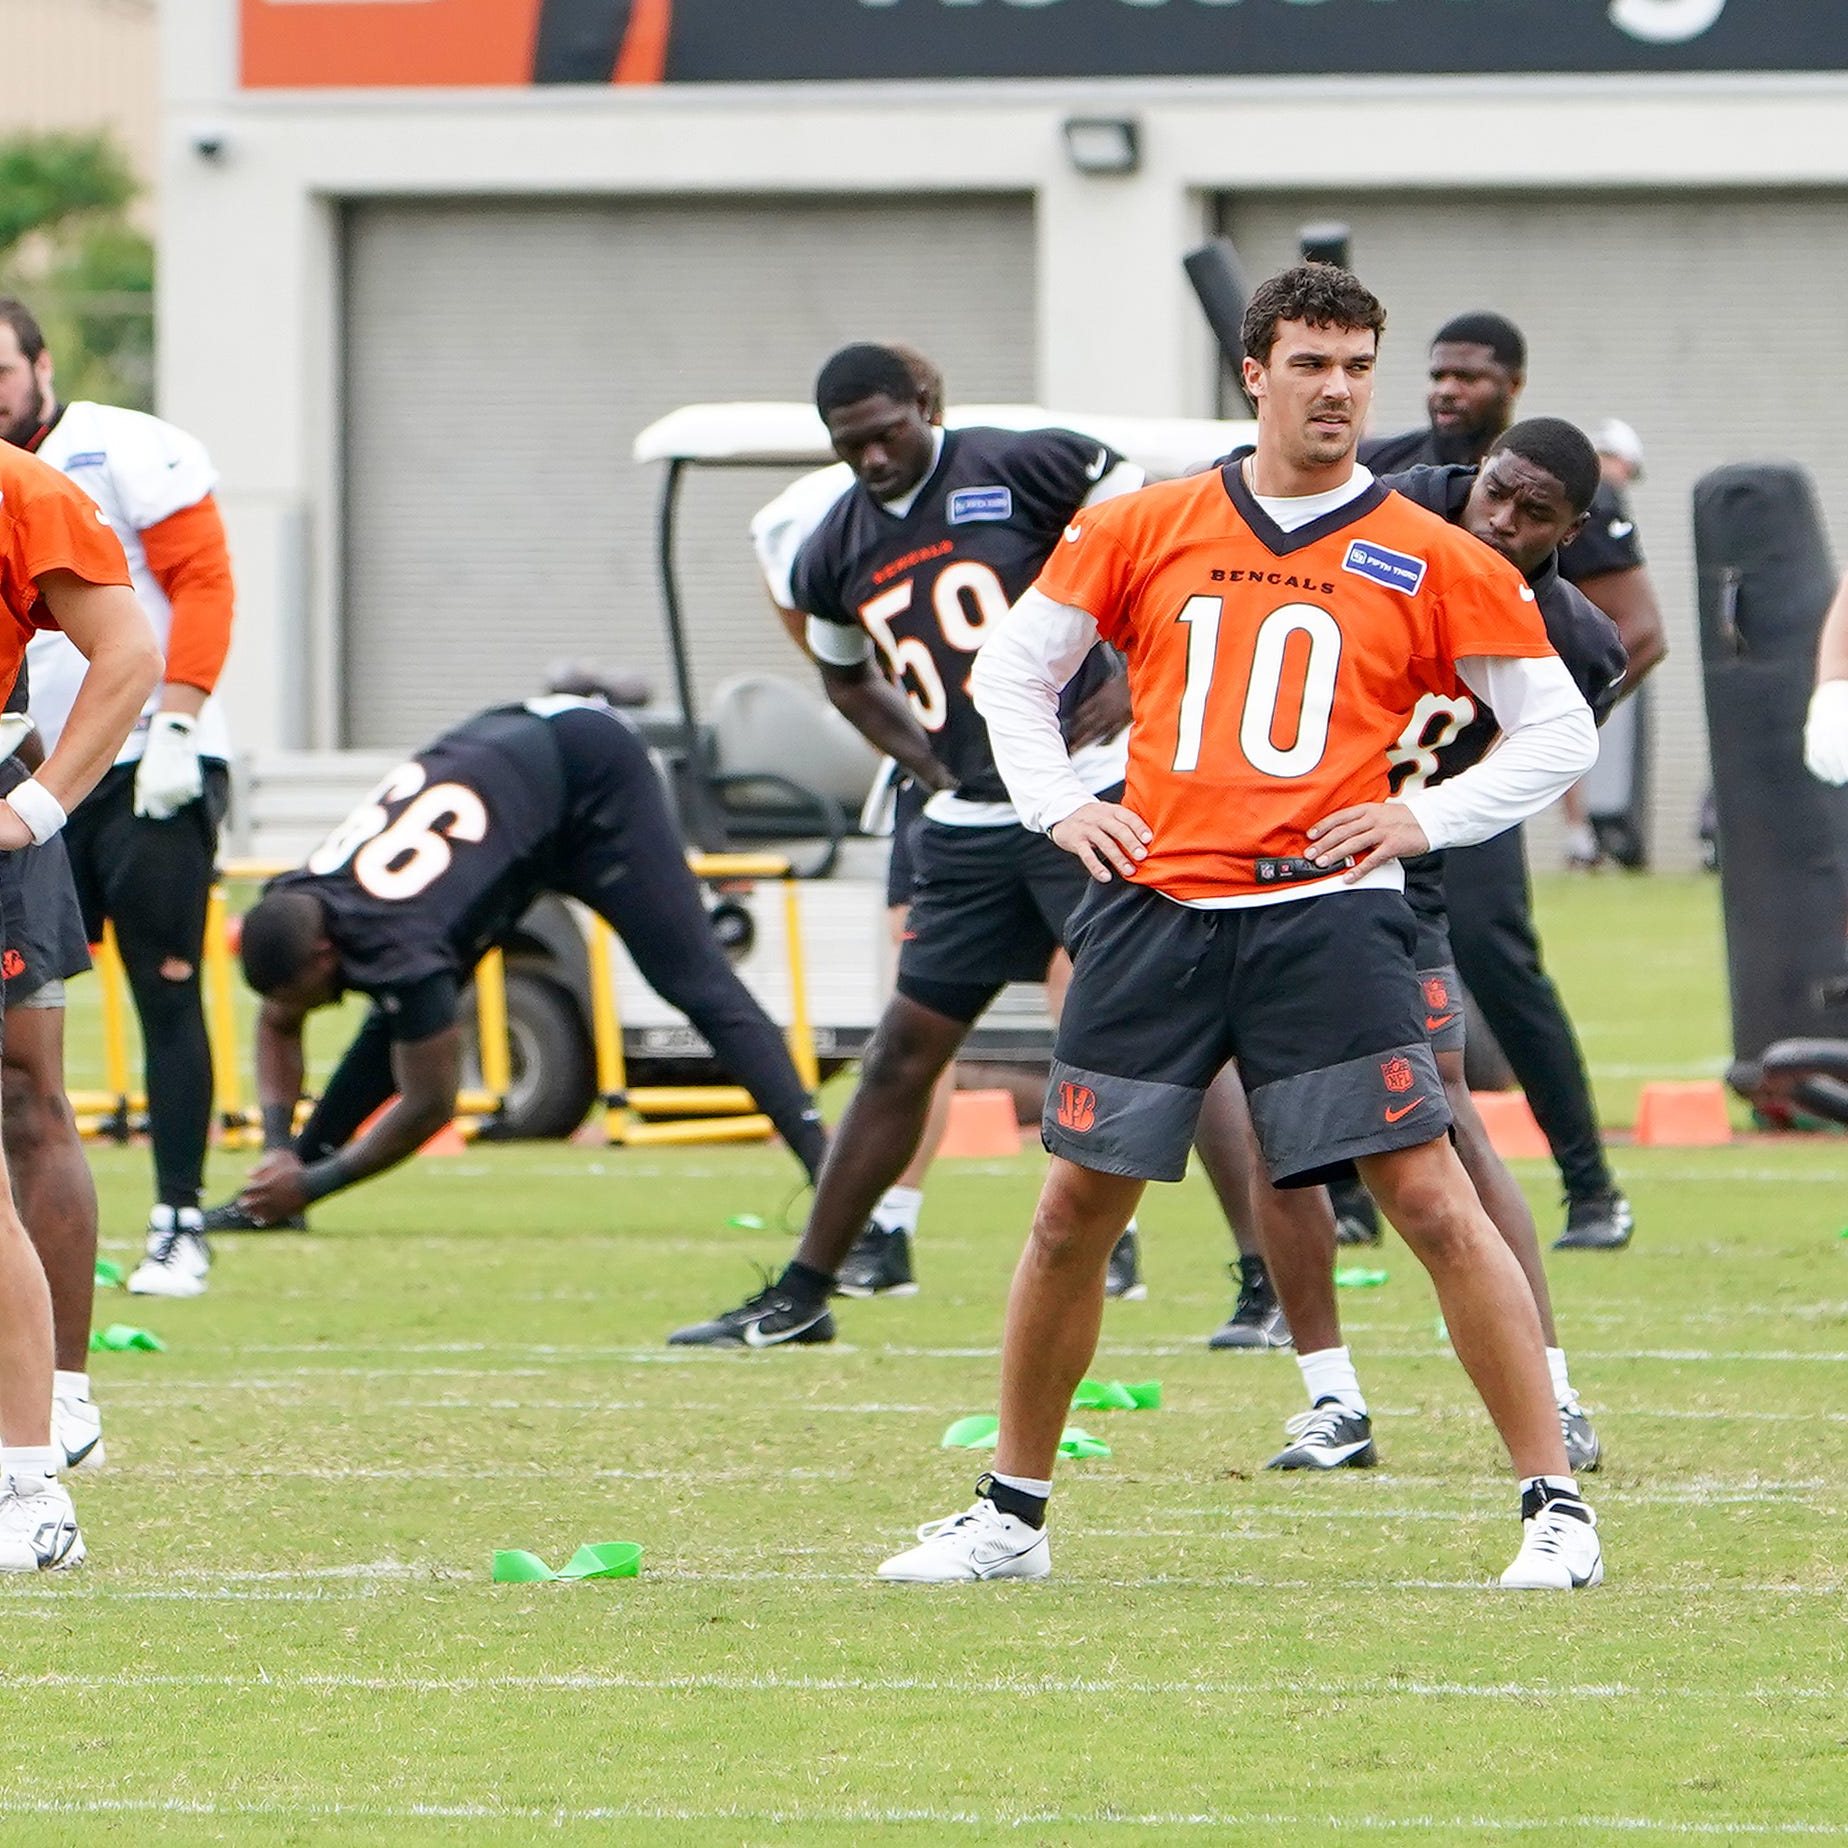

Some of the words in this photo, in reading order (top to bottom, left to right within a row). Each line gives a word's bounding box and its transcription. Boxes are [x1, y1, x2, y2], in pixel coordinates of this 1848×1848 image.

[856, 559, 1012, 734] 59
[1210, 568, 1336, 595] BENGALS
[1170, 593, 1342, 779] 10
[308, 760, 489, 901] 66
